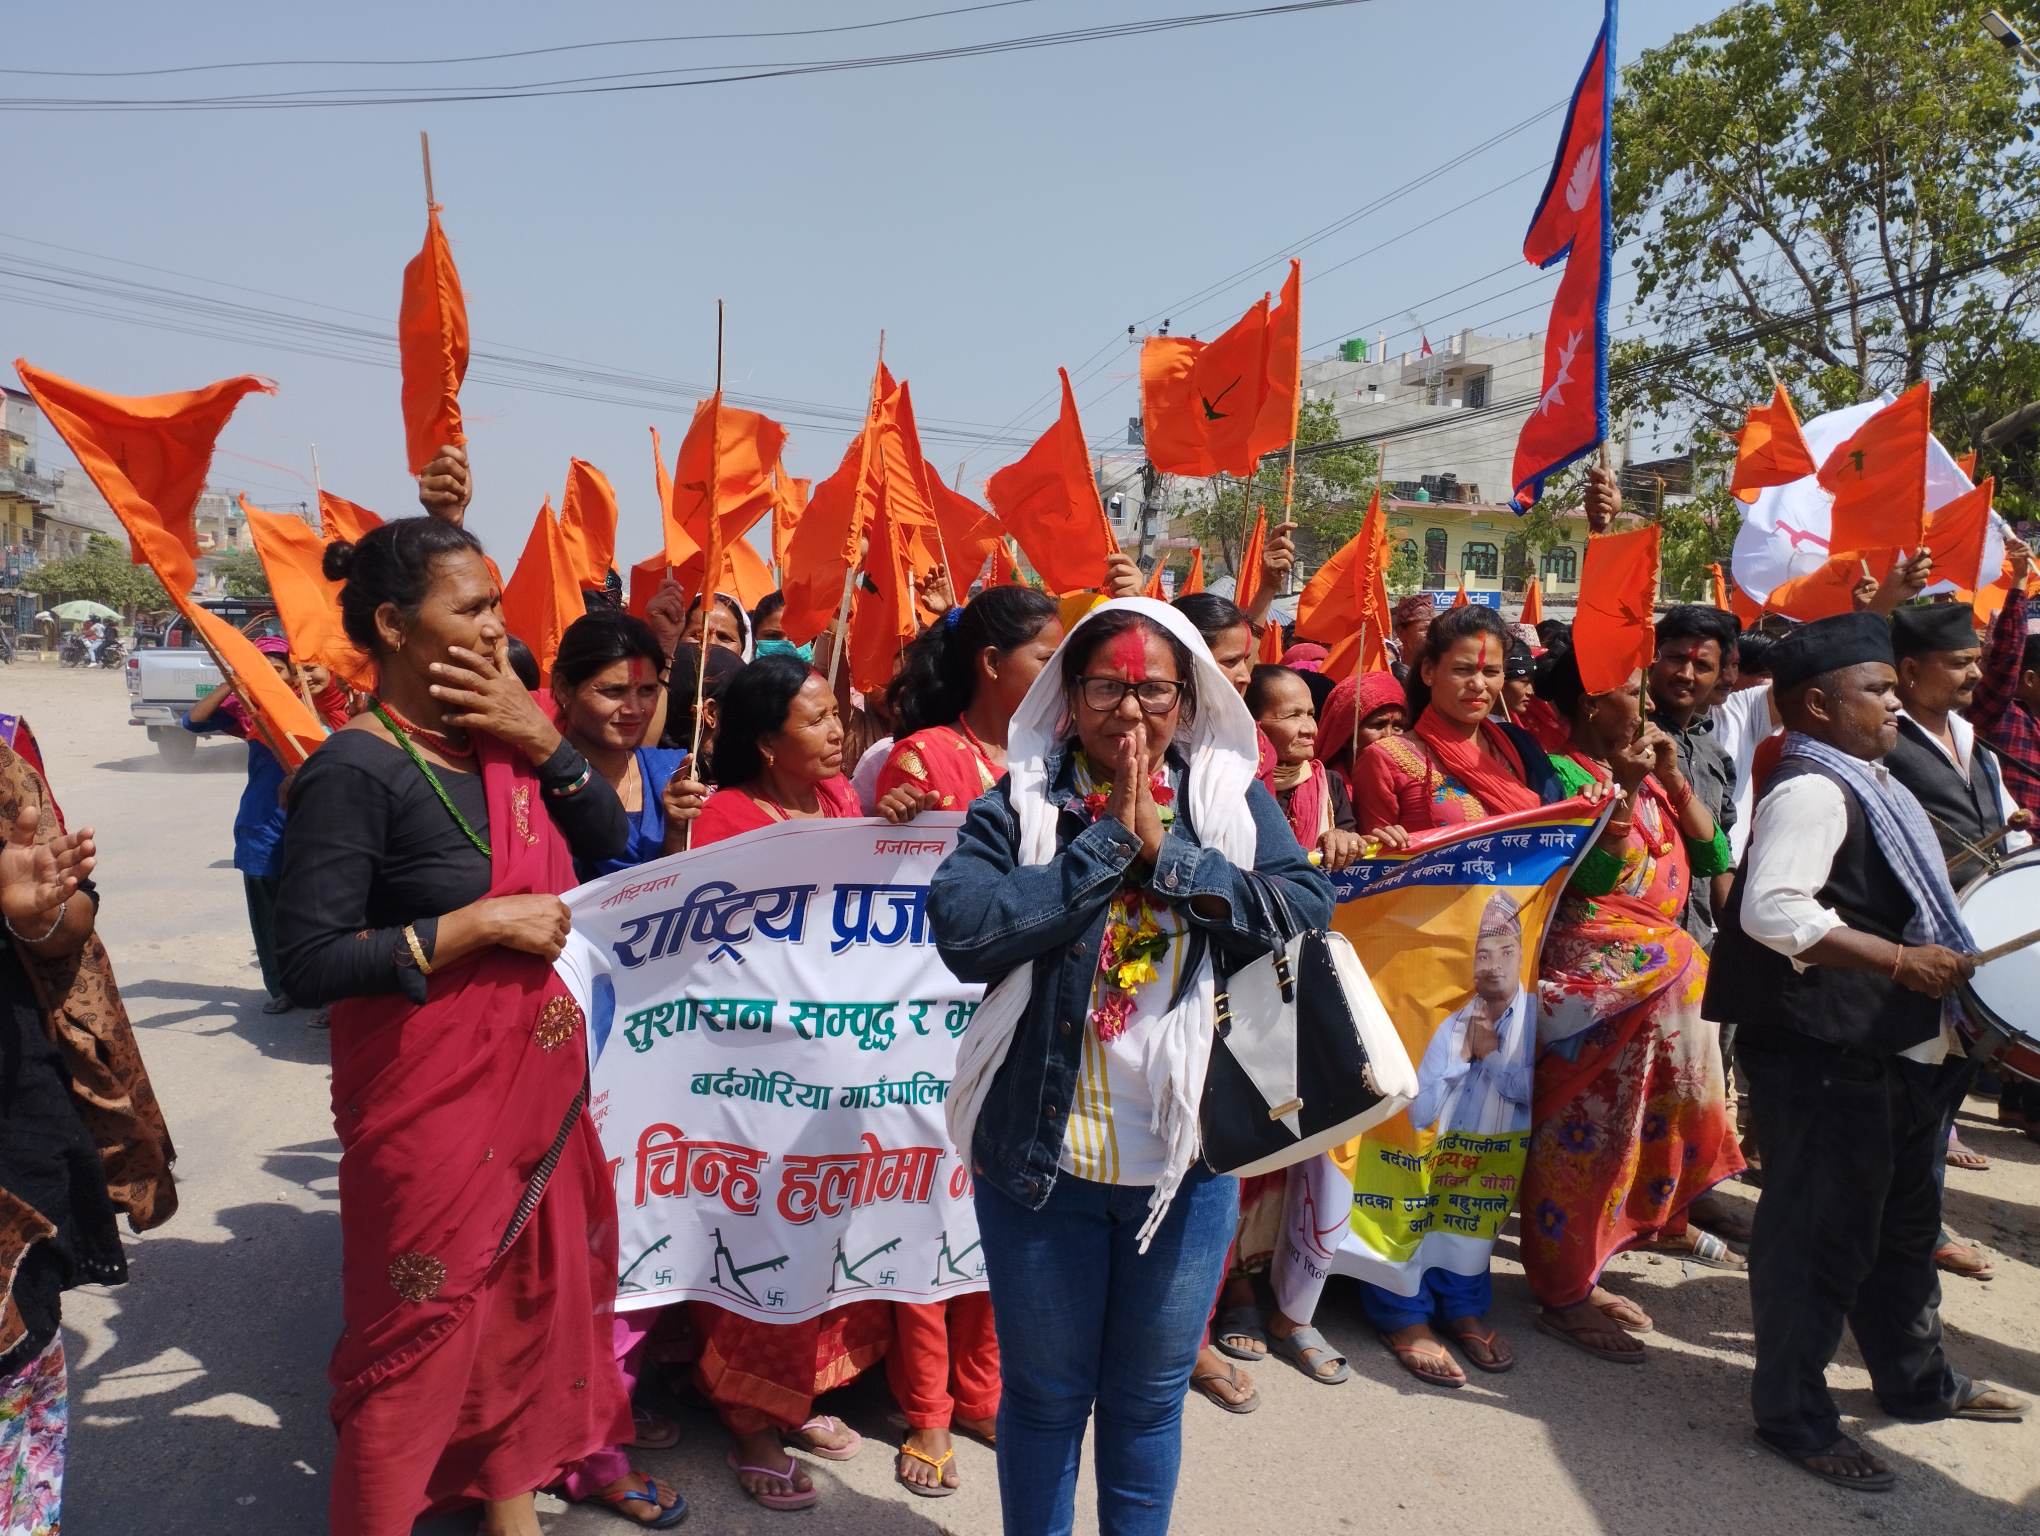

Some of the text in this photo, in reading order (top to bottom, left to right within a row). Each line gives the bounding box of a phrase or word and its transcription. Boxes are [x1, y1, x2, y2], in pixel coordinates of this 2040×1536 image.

[873, 839, 946, 856] प्रजातन्त्र
[1502, 833, 1532, 848] सरह
[1539, 828, 1577, 848] मानेर
[1411, 863, 1456, 879] संकल्प
[612, 880, 819, 969] राष्ट्रिय
[624, 998, 778, 1053] सुशासन
[908, 999, 938, 1036] र
[691, 1067, 834, 1110] बर्दगोरिया
[634, 1123, 768, 1215] चिन्ह
[777, 1132, 945, 1225] हलोमा
